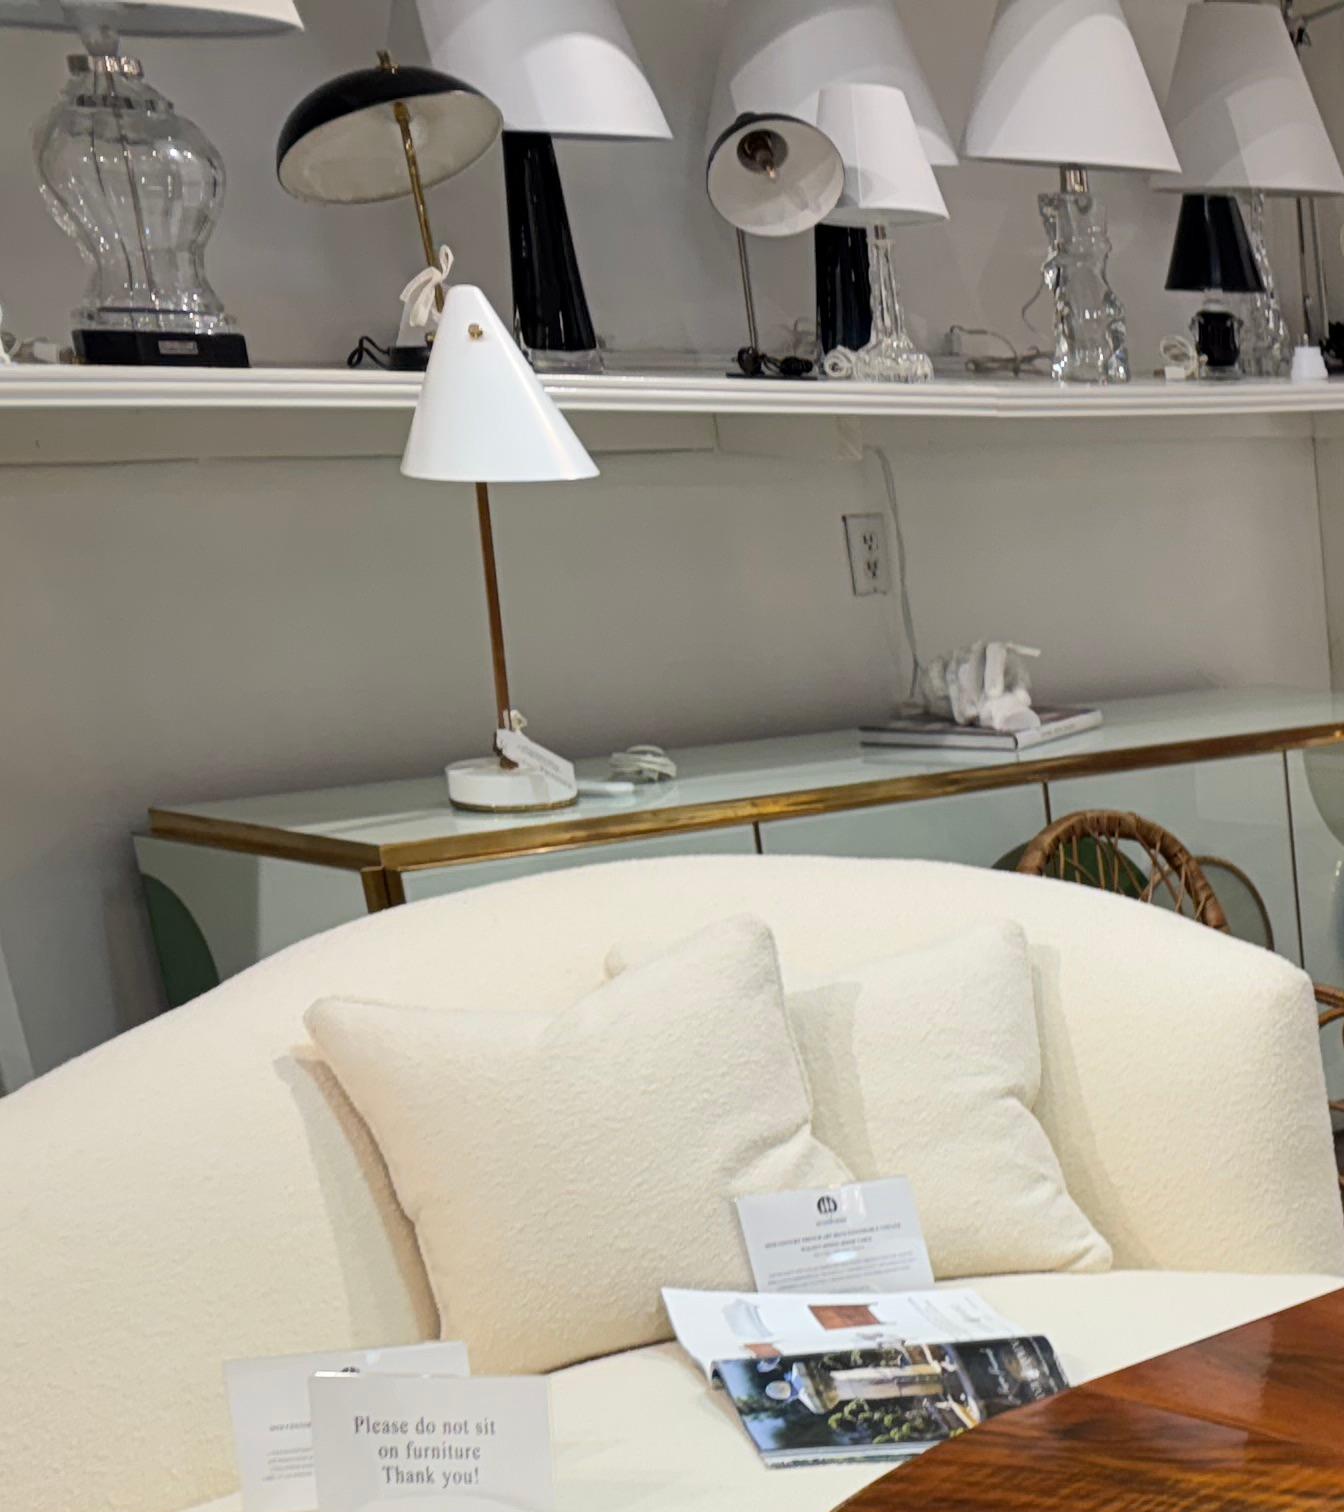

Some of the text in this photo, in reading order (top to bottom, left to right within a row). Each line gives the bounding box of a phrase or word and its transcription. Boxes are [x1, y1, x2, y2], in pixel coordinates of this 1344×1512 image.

[354, 1415, 496, 1435] Please do not sit
[378, 1441, 481, 1460] on furniture
[382, 1466, 479, 1488] Thank you!
